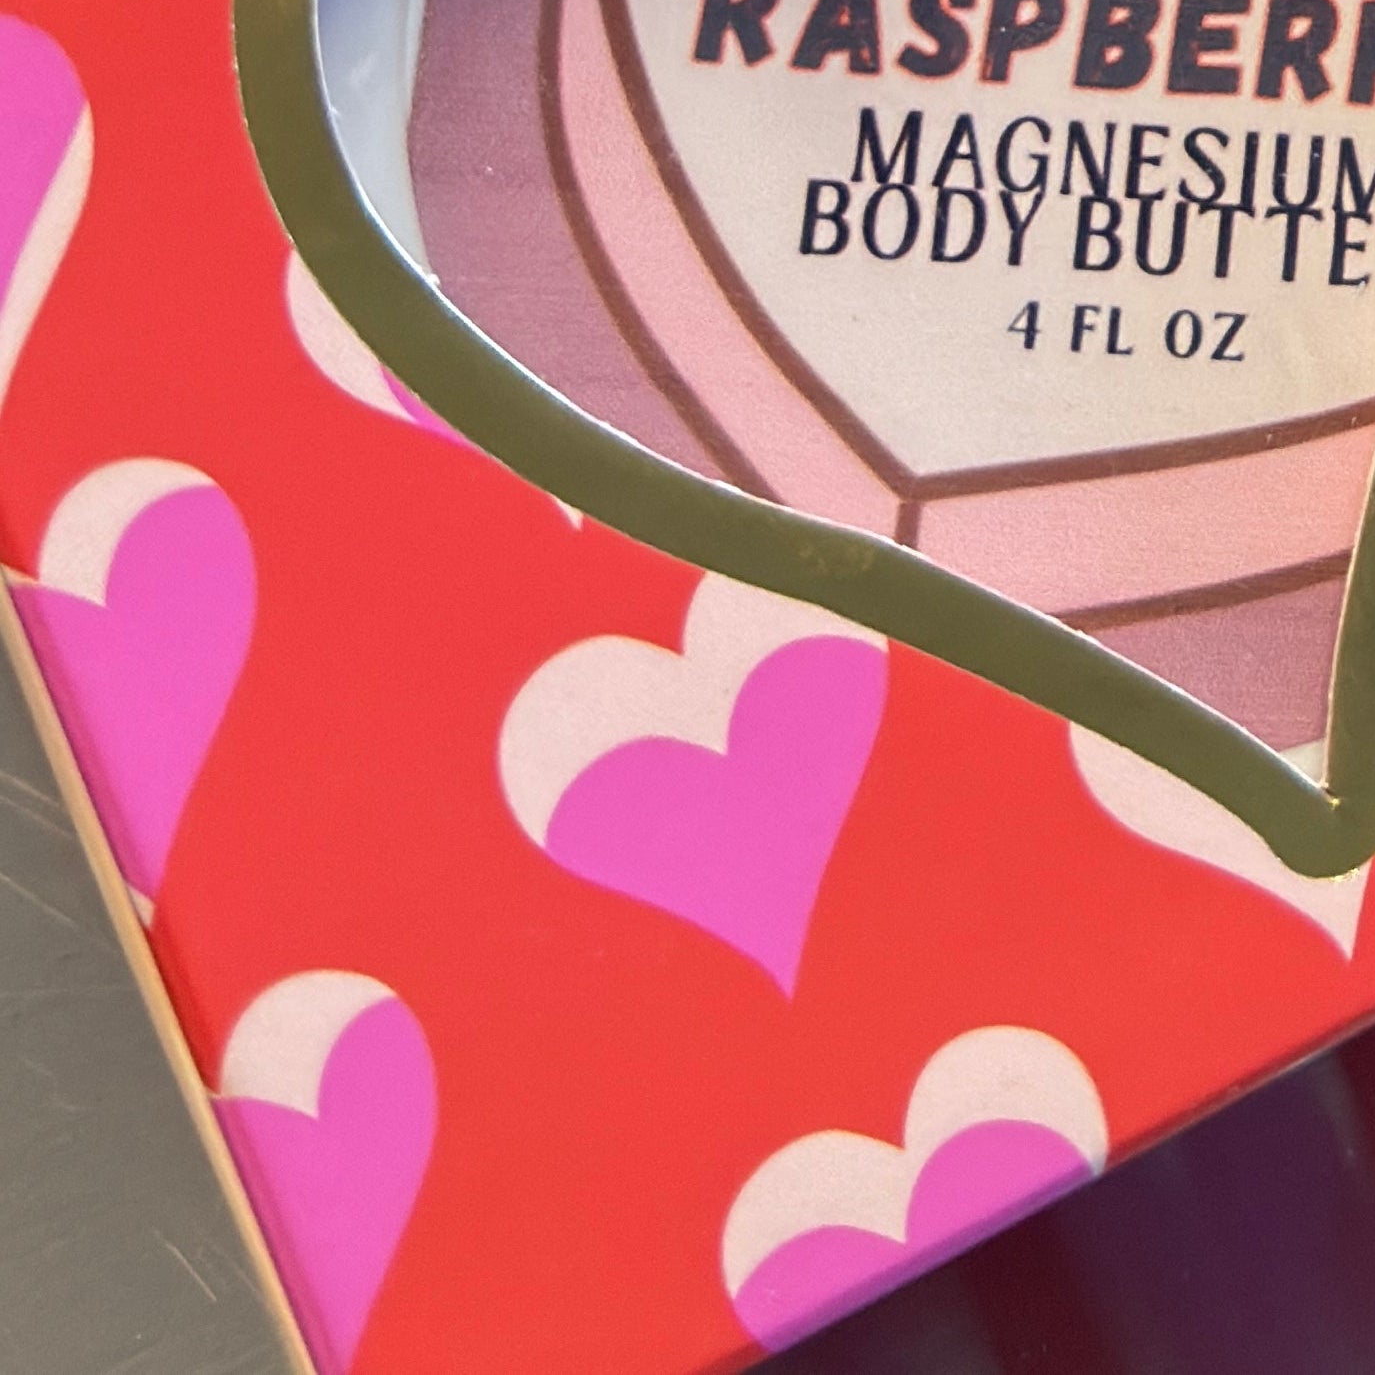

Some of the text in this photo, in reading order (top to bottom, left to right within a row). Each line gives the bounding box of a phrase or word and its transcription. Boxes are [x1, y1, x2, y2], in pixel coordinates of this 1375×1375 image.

[799, 178, 1044, 267] BODY
[1007, 300, 1248, 362] 4 FL OZ
